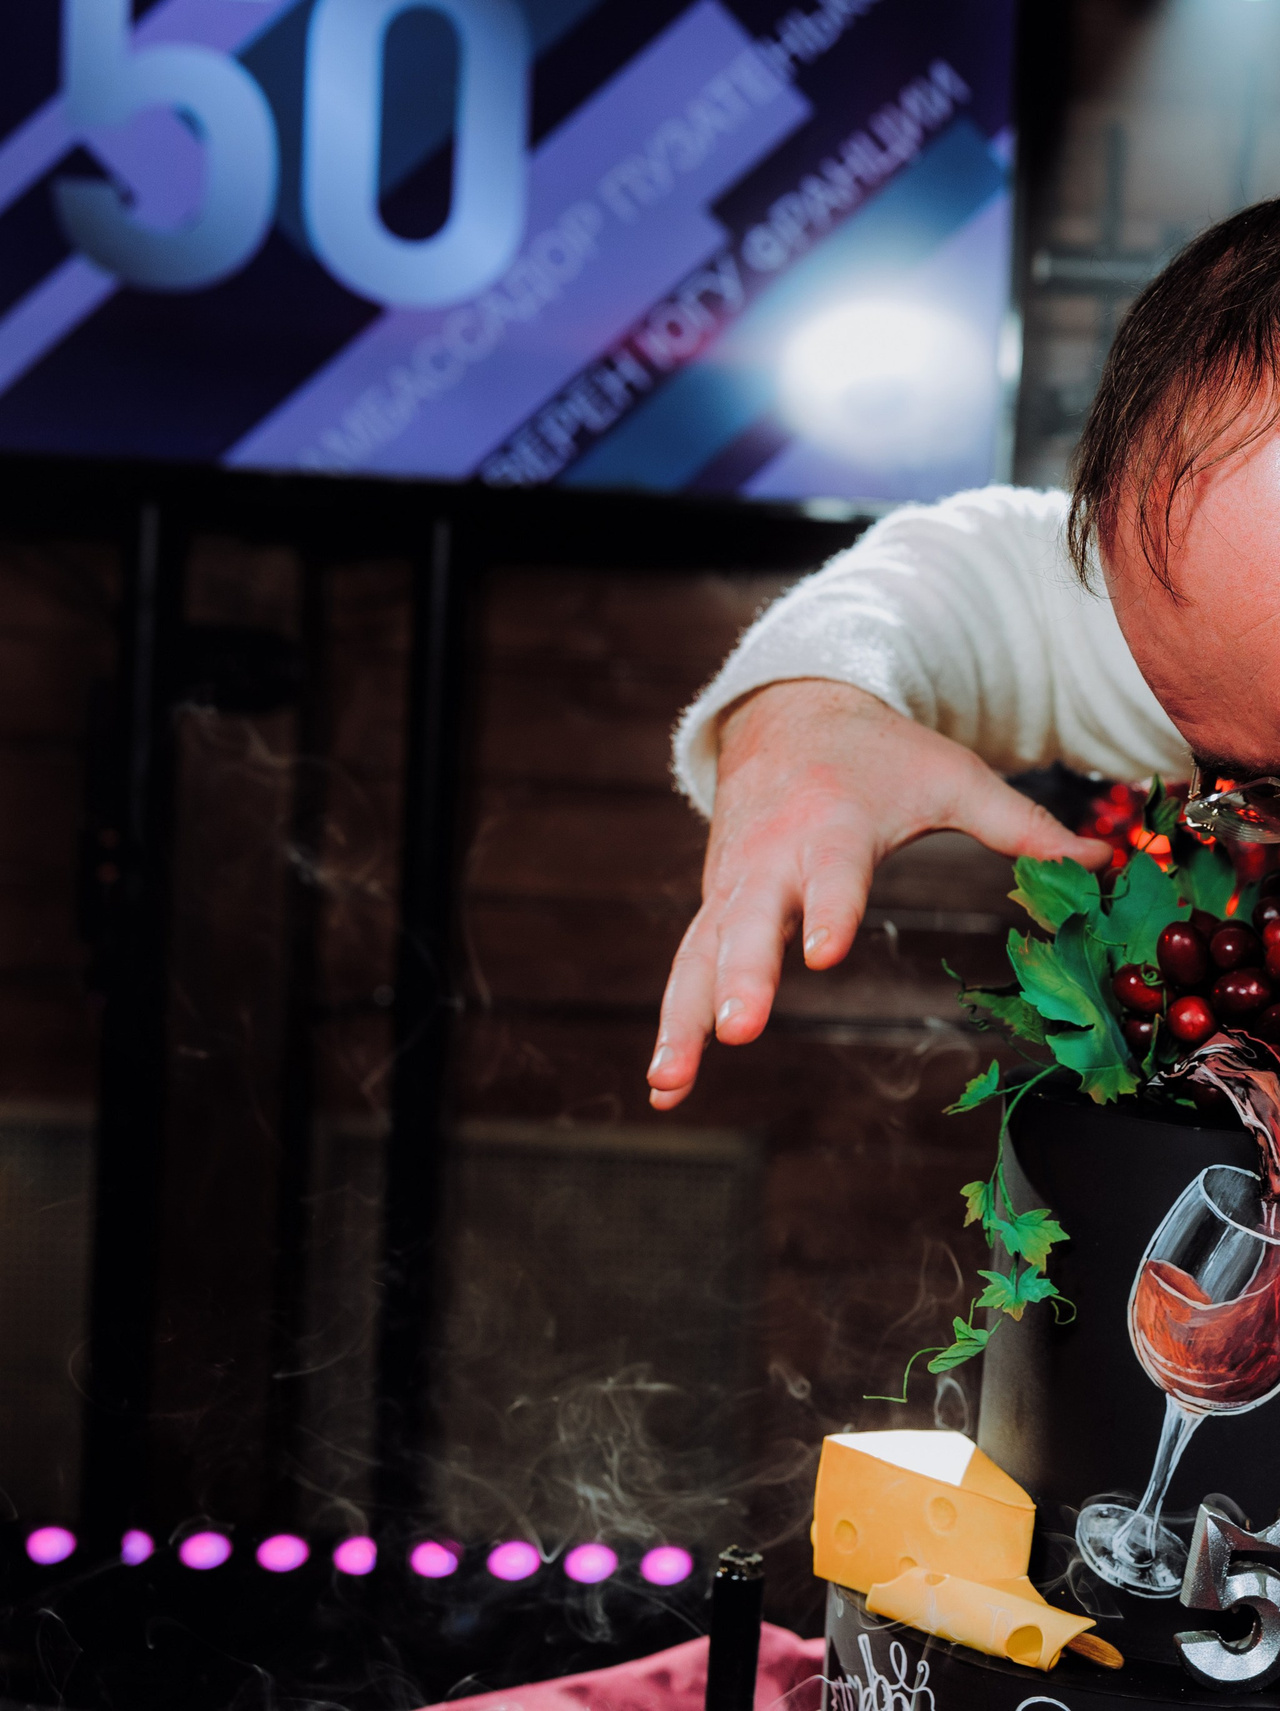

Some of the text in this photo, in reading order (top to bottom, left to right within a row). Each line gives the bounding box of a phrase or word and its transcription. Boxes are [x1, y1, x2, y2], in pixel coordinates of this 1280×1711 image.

[50, 0, 532, 310] 50
[630, 248, 746, 372] ЮГУ
[741, 57, 972, 273] ФРАНЦИИ
